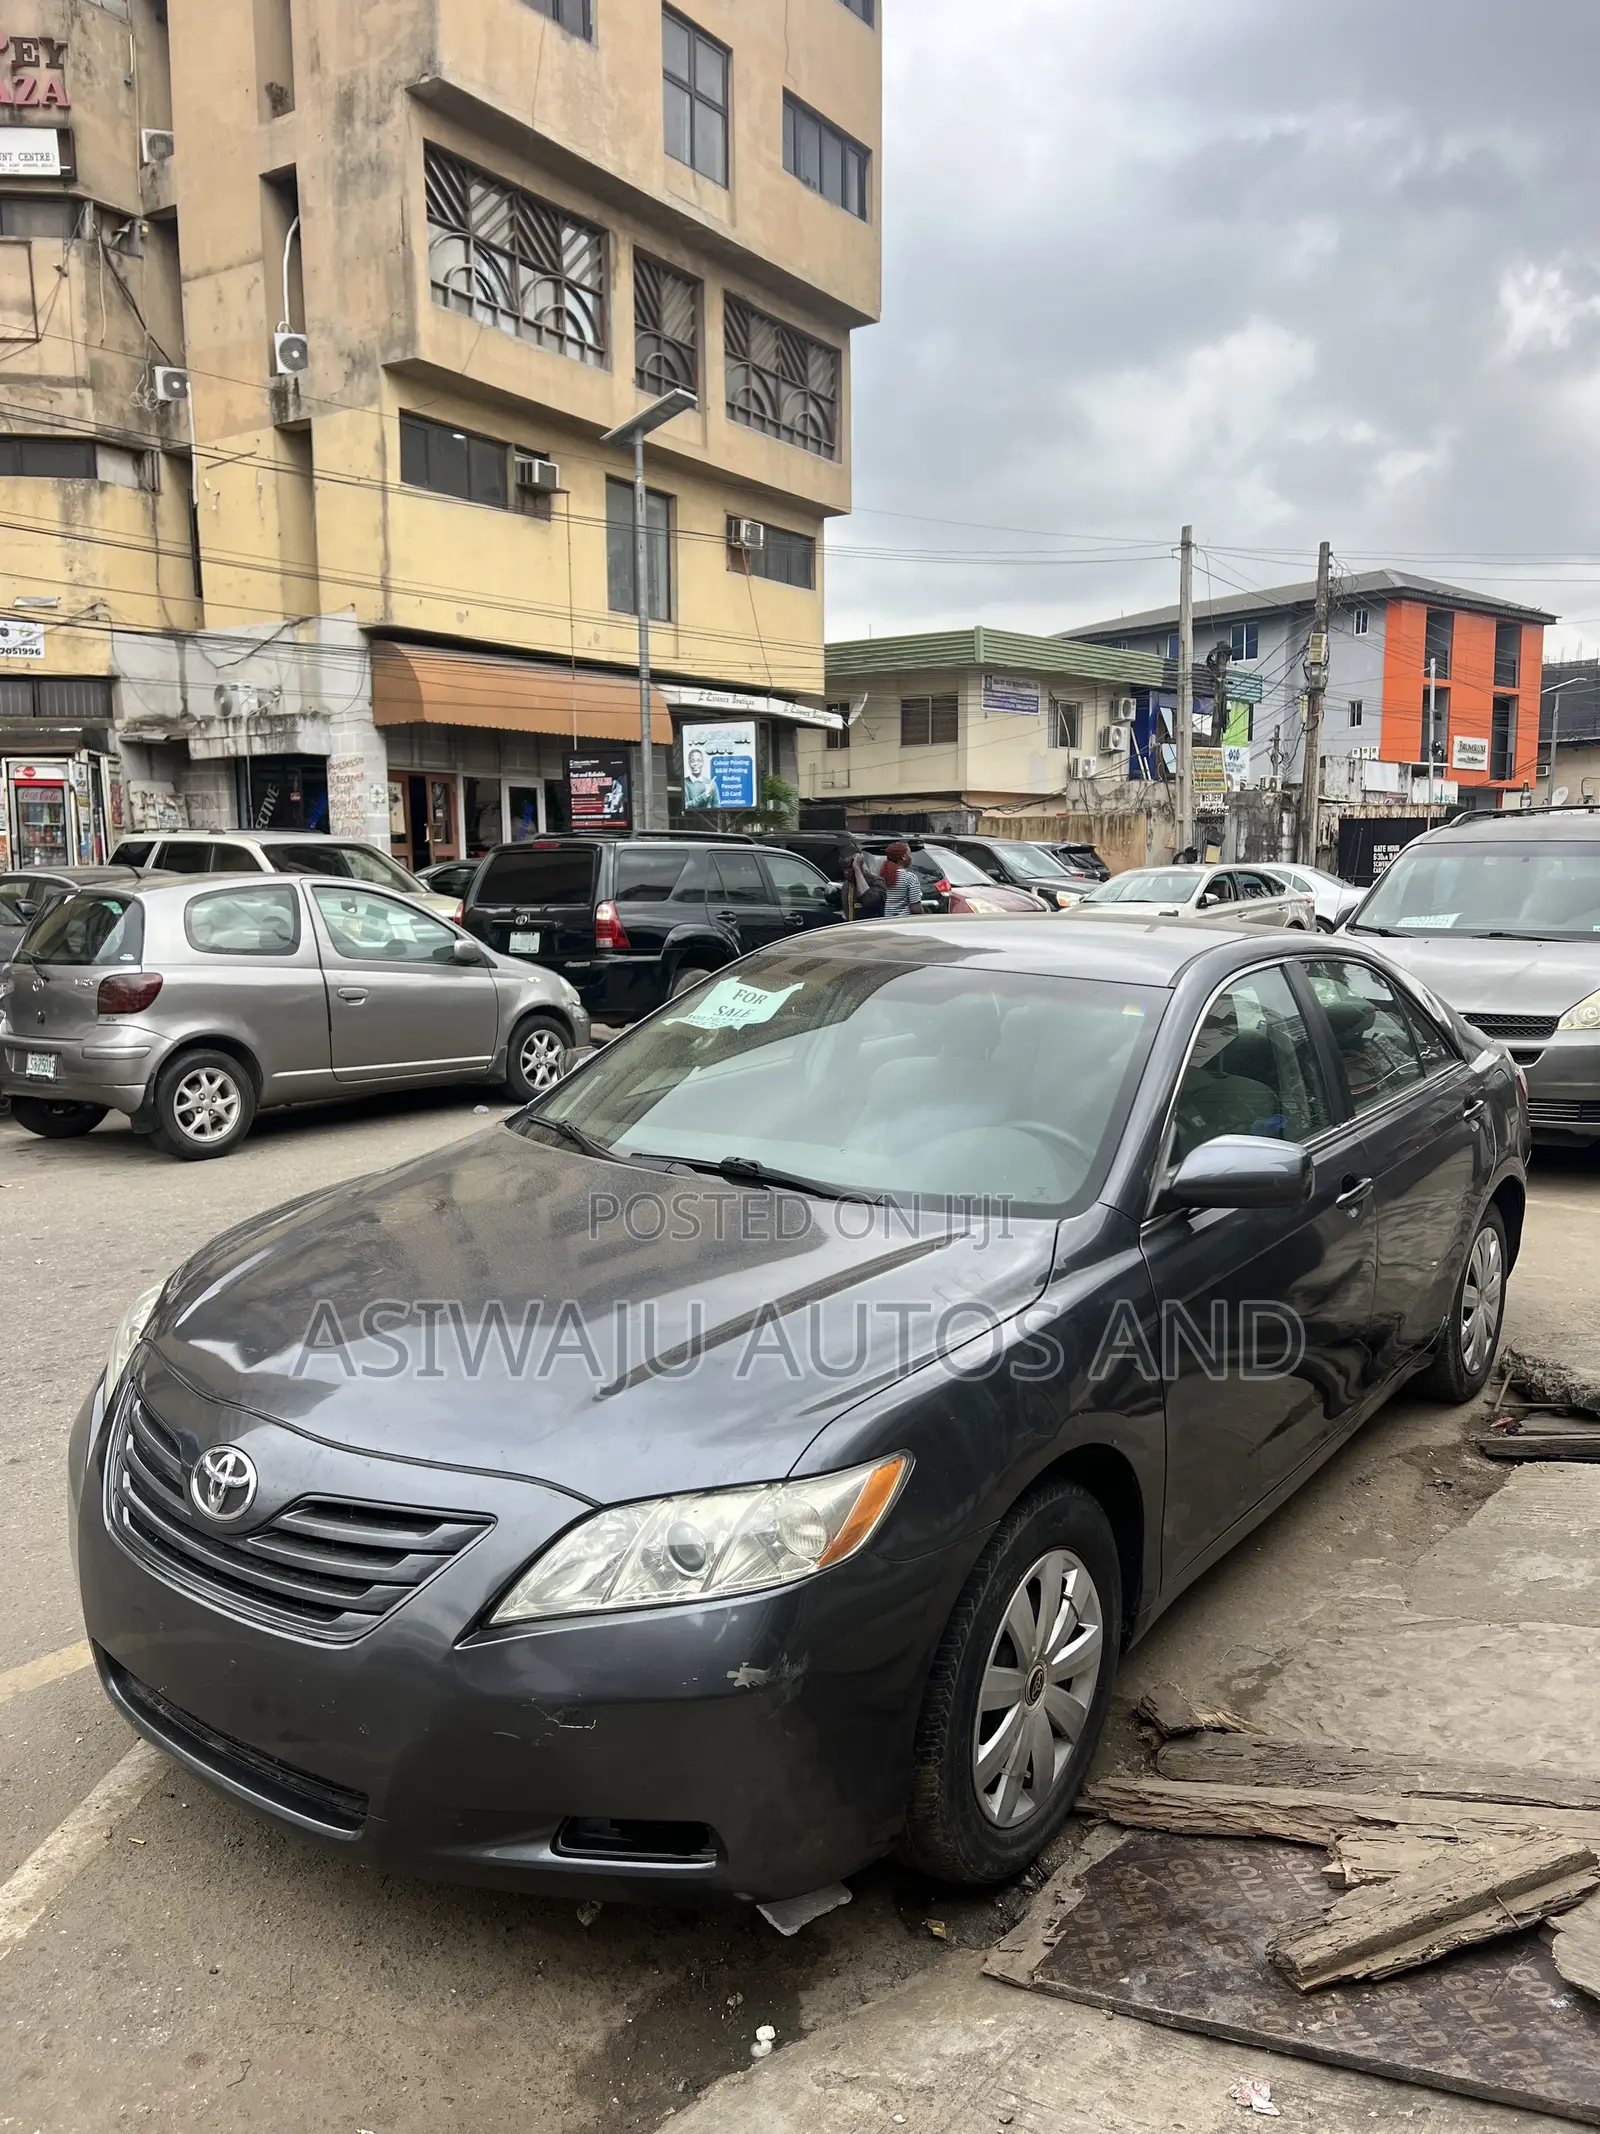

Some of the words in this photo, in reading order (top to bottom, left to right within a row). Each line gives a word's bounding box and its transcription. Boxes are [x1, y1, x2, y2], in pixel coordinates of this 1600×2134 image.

[18, 152, 54, 161] CENTRE)
[732, 988, 768, 1005] FOR
[713, 1005, 756, 1018] SALE
